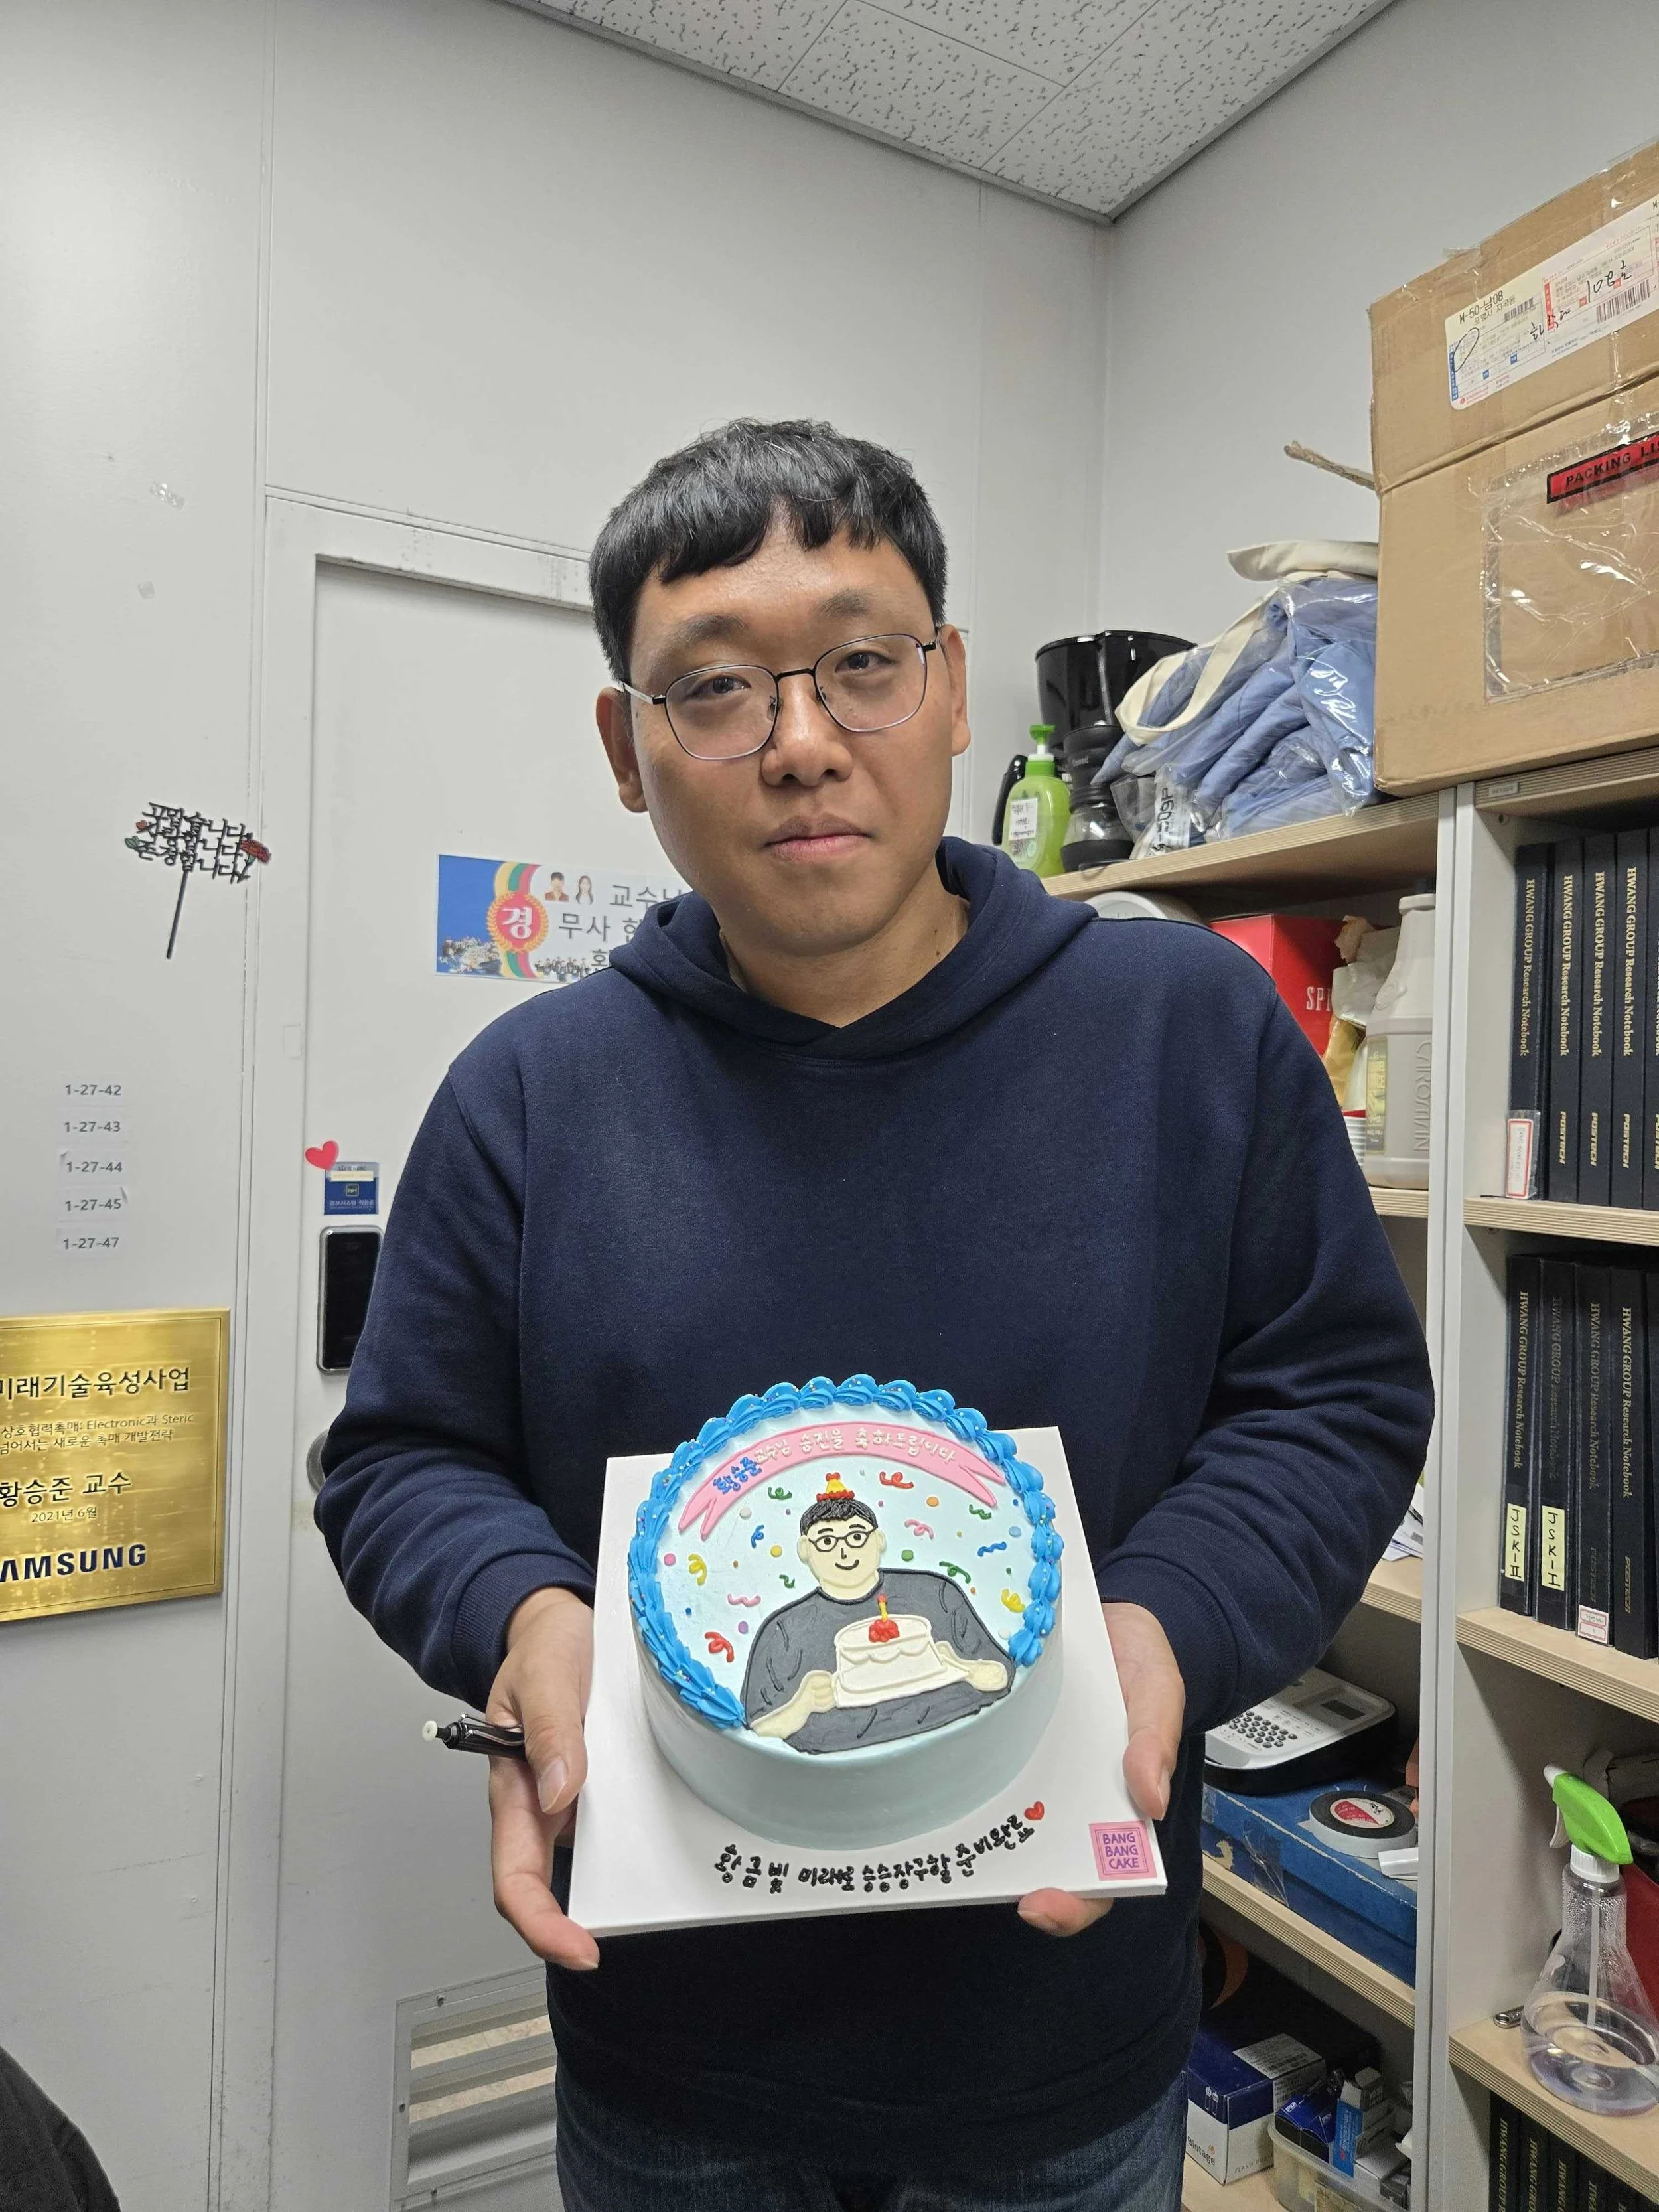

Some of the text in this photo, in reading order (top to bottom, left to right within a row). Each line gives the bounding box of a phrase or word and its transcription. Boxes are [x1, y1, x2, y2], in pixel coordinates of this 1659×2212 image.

[1565, 452, 1631, 487] PACKING
[502, 907, 533, 940] 경
[559, 913, 611, 942] 무사
[1520, 879, 1535, 1057] HWANG GROUP Research Notebook
[1559, 875, 1573, 1057] HWANG GROUP Research Notebook
[1591, 871, 1605, 1057] HWANG GROUP Research Notebook
[1623, 867, 1637, 1057] HWANG GROUP Research Notebook
[65, 1084, 122, 1096] 1-27-42
[64, 1121, 121, 1132] 1-27-43
[66, 1161, 123, 1173] 1-27-44
[65, 1199, 122, 1211] 1-27-45
[64, 1237, 119, 1250] 1-27-47
[1591, 1303, 1600, 1348] HWANG
[1514, 1291, 1529, 1468] HWANG GROUP Research Notebook
[1551, 1343, 1561, 1384] GROUP
[1590, 1350, 1600, 1392] GROUP
[0, 1367, 190, 1399] 미래기술육성사업
[1589, 1393, 1599, 1437] Research
[1623, 1307, 1632, 1499] HWANG GROUP Research Notebook
[1, 1413, 194, 1439] 상호협력촉매: Electronic과 Steric
[53, 1434, 93, 1449] 새로운
[96, 1432, 121, 1447] 촉매
[124, 1428, 175, 1443] 개발전략
[754, 1438, 792, 1464] 교수님
[800, 1428, 844, 1455] 승진을
[0, 1471, 132, 1508] 황승준 교수
[31, 1506, 98, 1522] 2021년 6월
[1102, 1832, 1135, 1845] BANG
[1105, 1845, 1138, 1857] BANG
[798, 1866, 855, 1891] 미래로
[1109, 1858, 1139, 1869] CAKE
[1187, 2136, 1216, 2166] Biotage
[1500, 2118, 1508, 2163] HWANG
[1529, 2138, 1538, 2185] HWANG
[1498, 2164, 1507, 2205] GROUP
